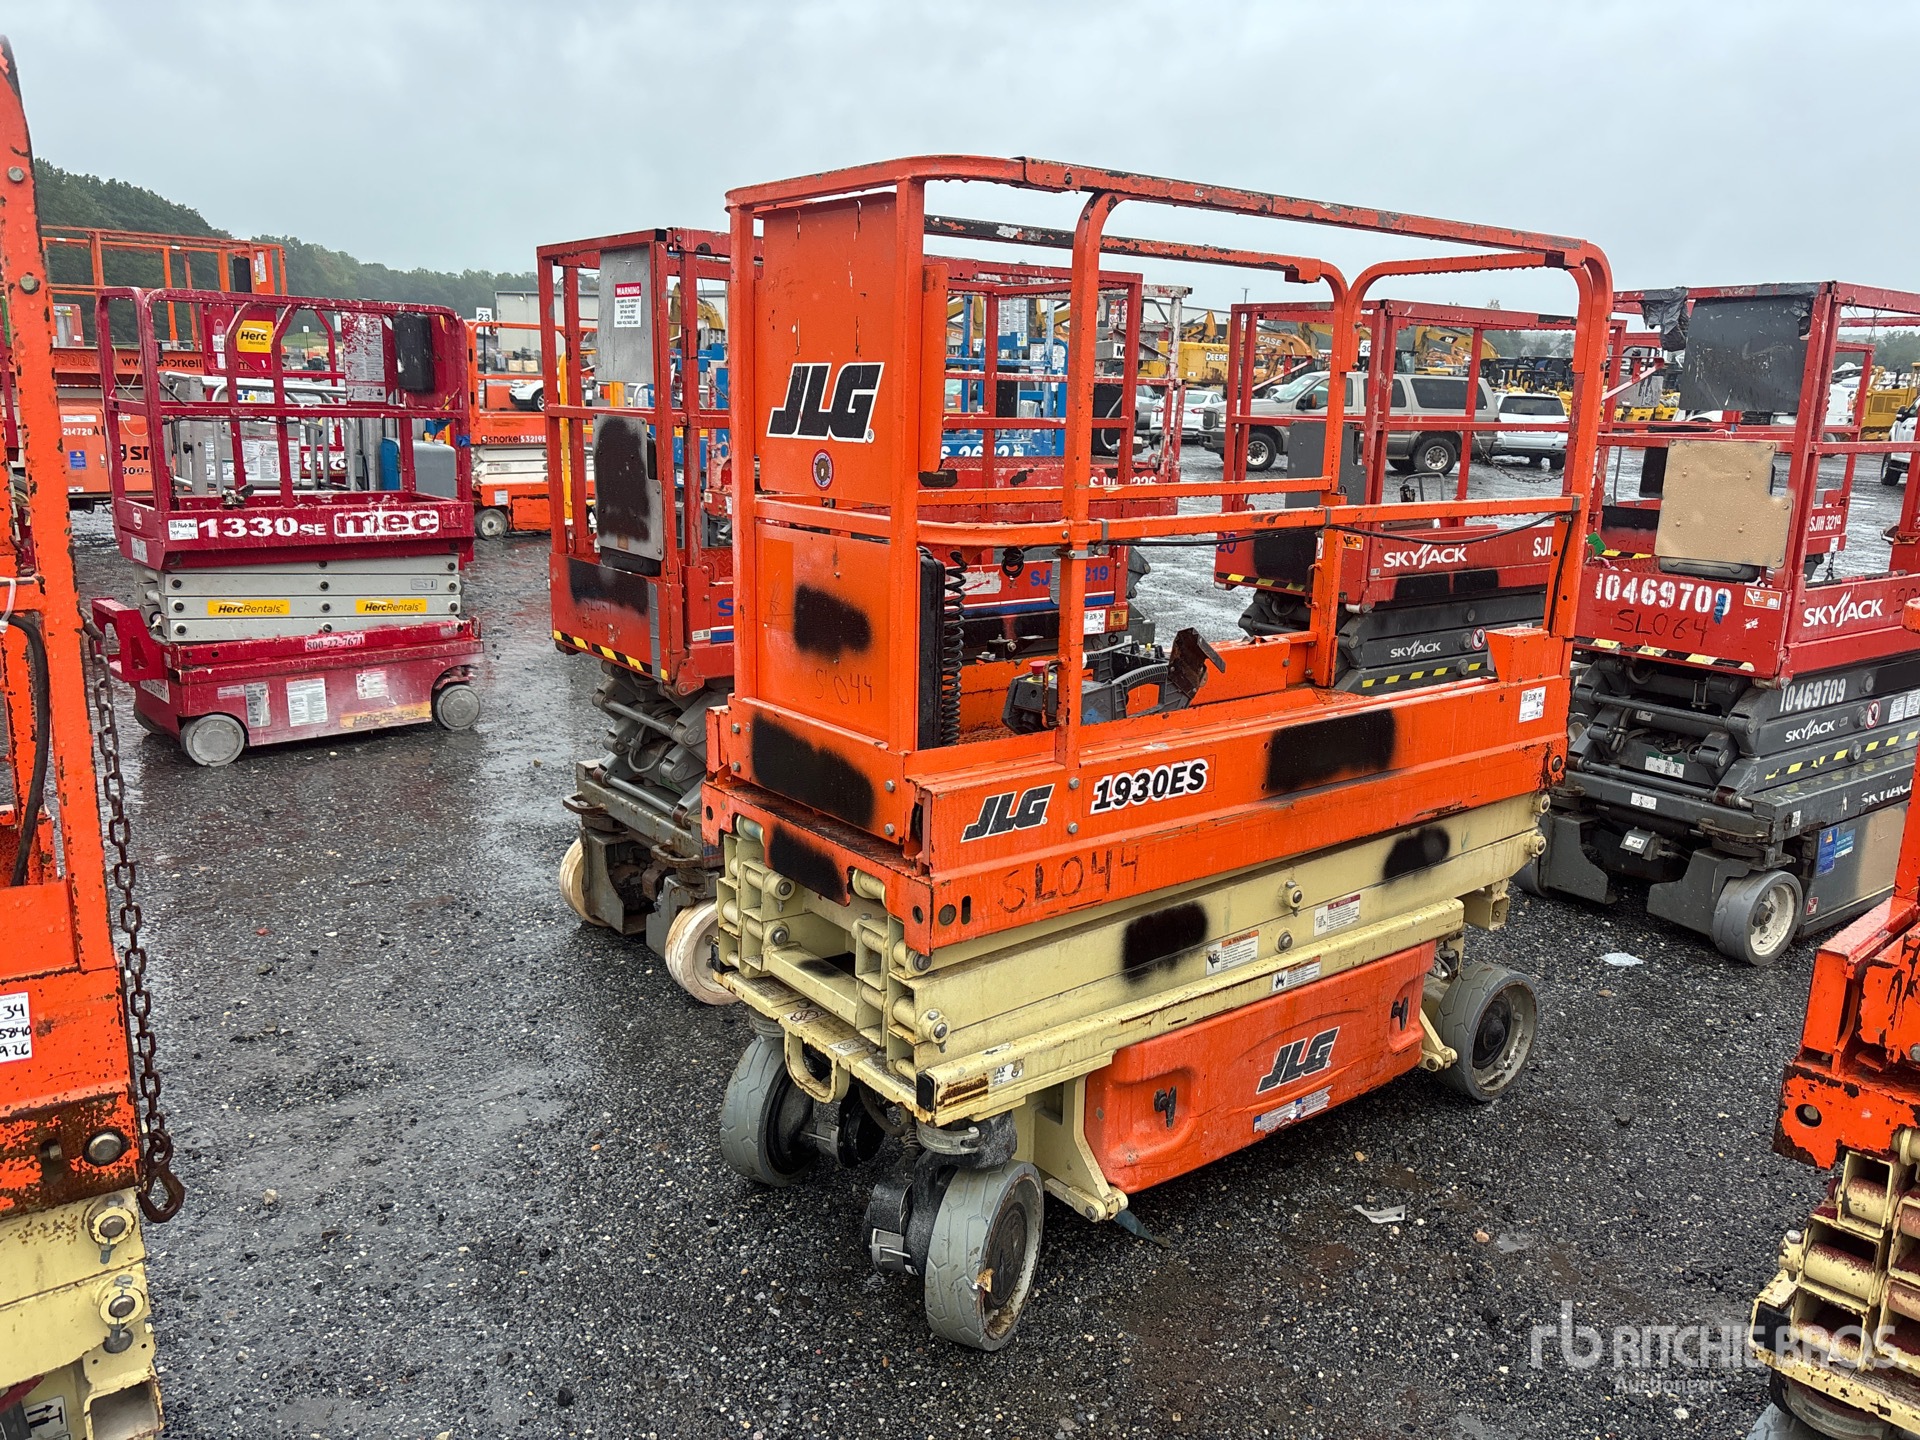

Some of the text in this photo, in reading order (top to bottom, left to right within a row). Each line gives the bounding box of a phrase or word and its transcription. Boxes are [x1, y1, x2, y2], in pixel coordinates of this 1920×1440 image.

[616, 286, 640, 295] WARNING
[478, 313, 490, 321] 23
[240, 331, 267, 341] Herc
[1258, 334, 1283, 347] CASE
[1205, 352, 1228, 362] DEERE
[766, 362, 885, 443] JLG
[62, 427, 93, 436] 214720
[335, 510, 439, 537] mec
[1383, 543, 1468, 569] SKYJACK
[1803, 592, 1884, 628] SKYJACK
[306, 636, 364, 651] 800-22-7671
[1390, 639, 1441, 659] SKYJACK
[1779, 678, 1847, 713] 10469709
[1784, 719, 1836, 743] SKYJACK
[1091, 760, 1208, 813] 1930ES
[960, 784, 1055, 842] JLG
[998, 845, 1140, 914] SL044
[1256, 1026, 1340, 1095] JLG
